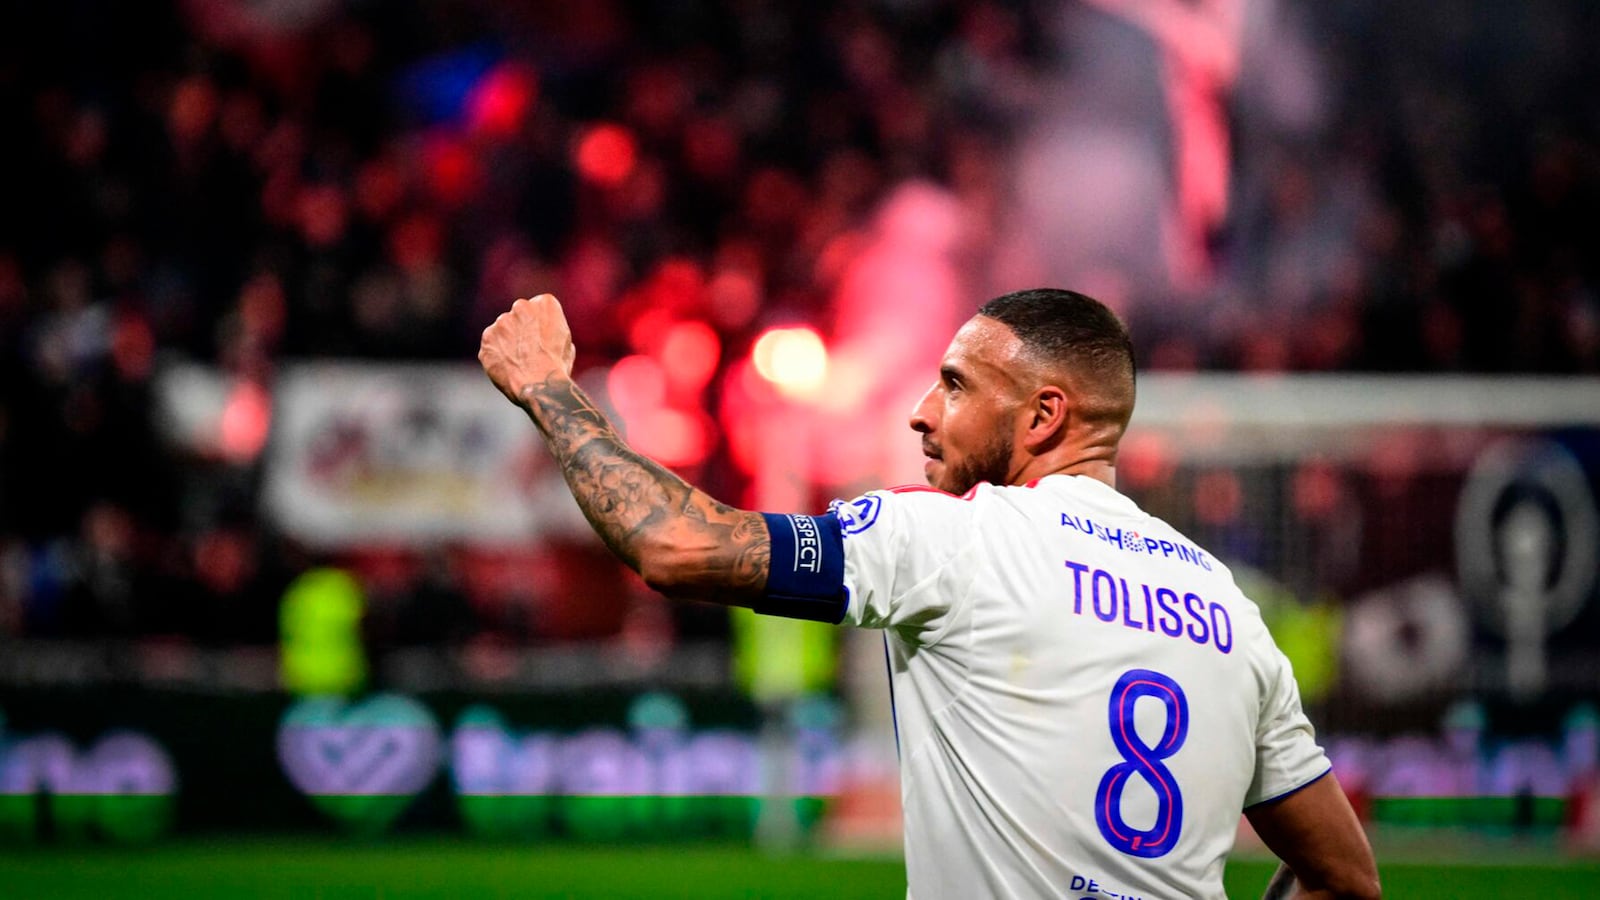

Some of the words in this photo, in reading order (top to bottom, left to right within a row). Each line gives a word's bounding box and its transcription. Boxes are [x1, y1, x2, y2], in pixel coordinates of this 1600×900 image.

[1060, 512, 1212, 572] AUSHOPPING
[1065, 560, 1232, 655] TOLISSO
[1094, 668, 1190, 859] 8
